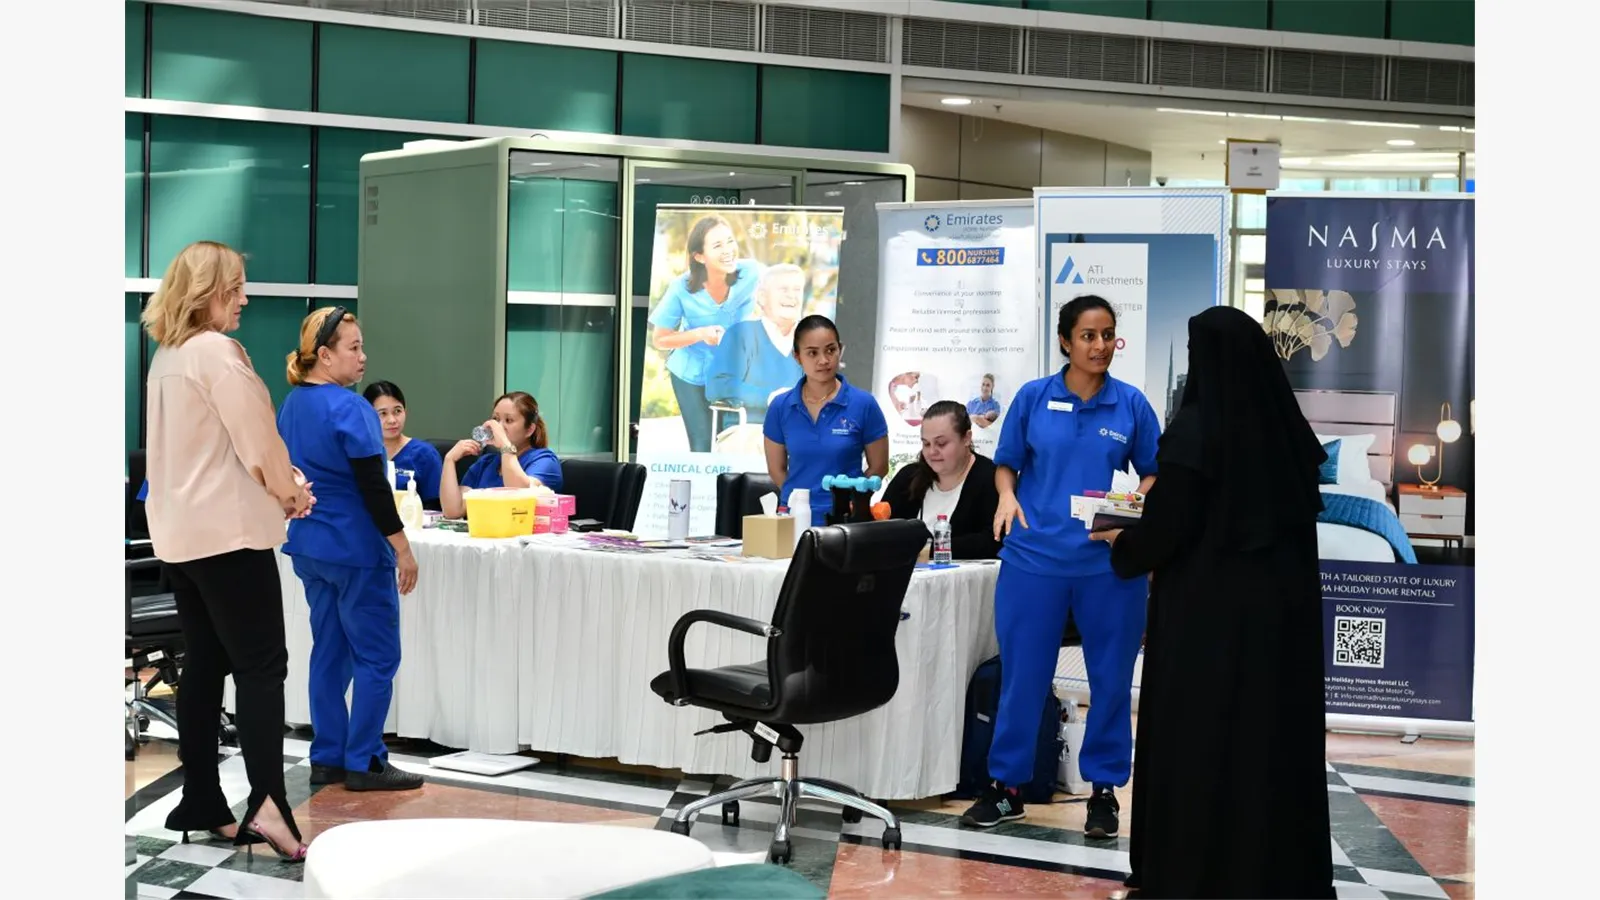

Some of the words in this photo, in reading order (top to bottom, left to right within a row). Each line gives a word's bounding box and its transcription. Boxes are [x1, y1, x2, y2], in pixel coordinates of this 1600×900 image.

[946, 213, 1003, 226] Emirates
[1308, 221, 1447, 252] NASMA
[936, 249, 967, 265] 800
[967, 256, 999, 264] 6877464
[1087, 265, 1104, 274] ATI
[1326, 258, 1380, 269] LUXURY
[1386, 260, 1427, 271] STAYS
[1087, 275, 1144, 286] investments
[981, 326, 996, 334] clock
[650, 463, 703, 474] CLINICAL
[704, 464, 734, 475] CARE
[1320, 572, 1332, 581] TH
[1333, 573, 1340, 581] A
[1342, 573, 1382, 584] TAILORED
[1383, 575, 1408, 585] STATE
[1409, 576, 1421, 586] OF
[1423, 577, 1457, 588] LUXURY
[1333, 585, 1371, 595] HOLIDAY
[1372, 587, 1399, 596] HOME
[1400, 588, 1436, 598] RENTALS
[1335, 604, 1361, 613] BOOK
[1362, 606, 1387, 615] NOW
[1331, 676, 1354, 685] Holiday
[1403, 688, 1415, 696] City
[1324, 700, 1402, 710] w.nasmaluxurystays.com
